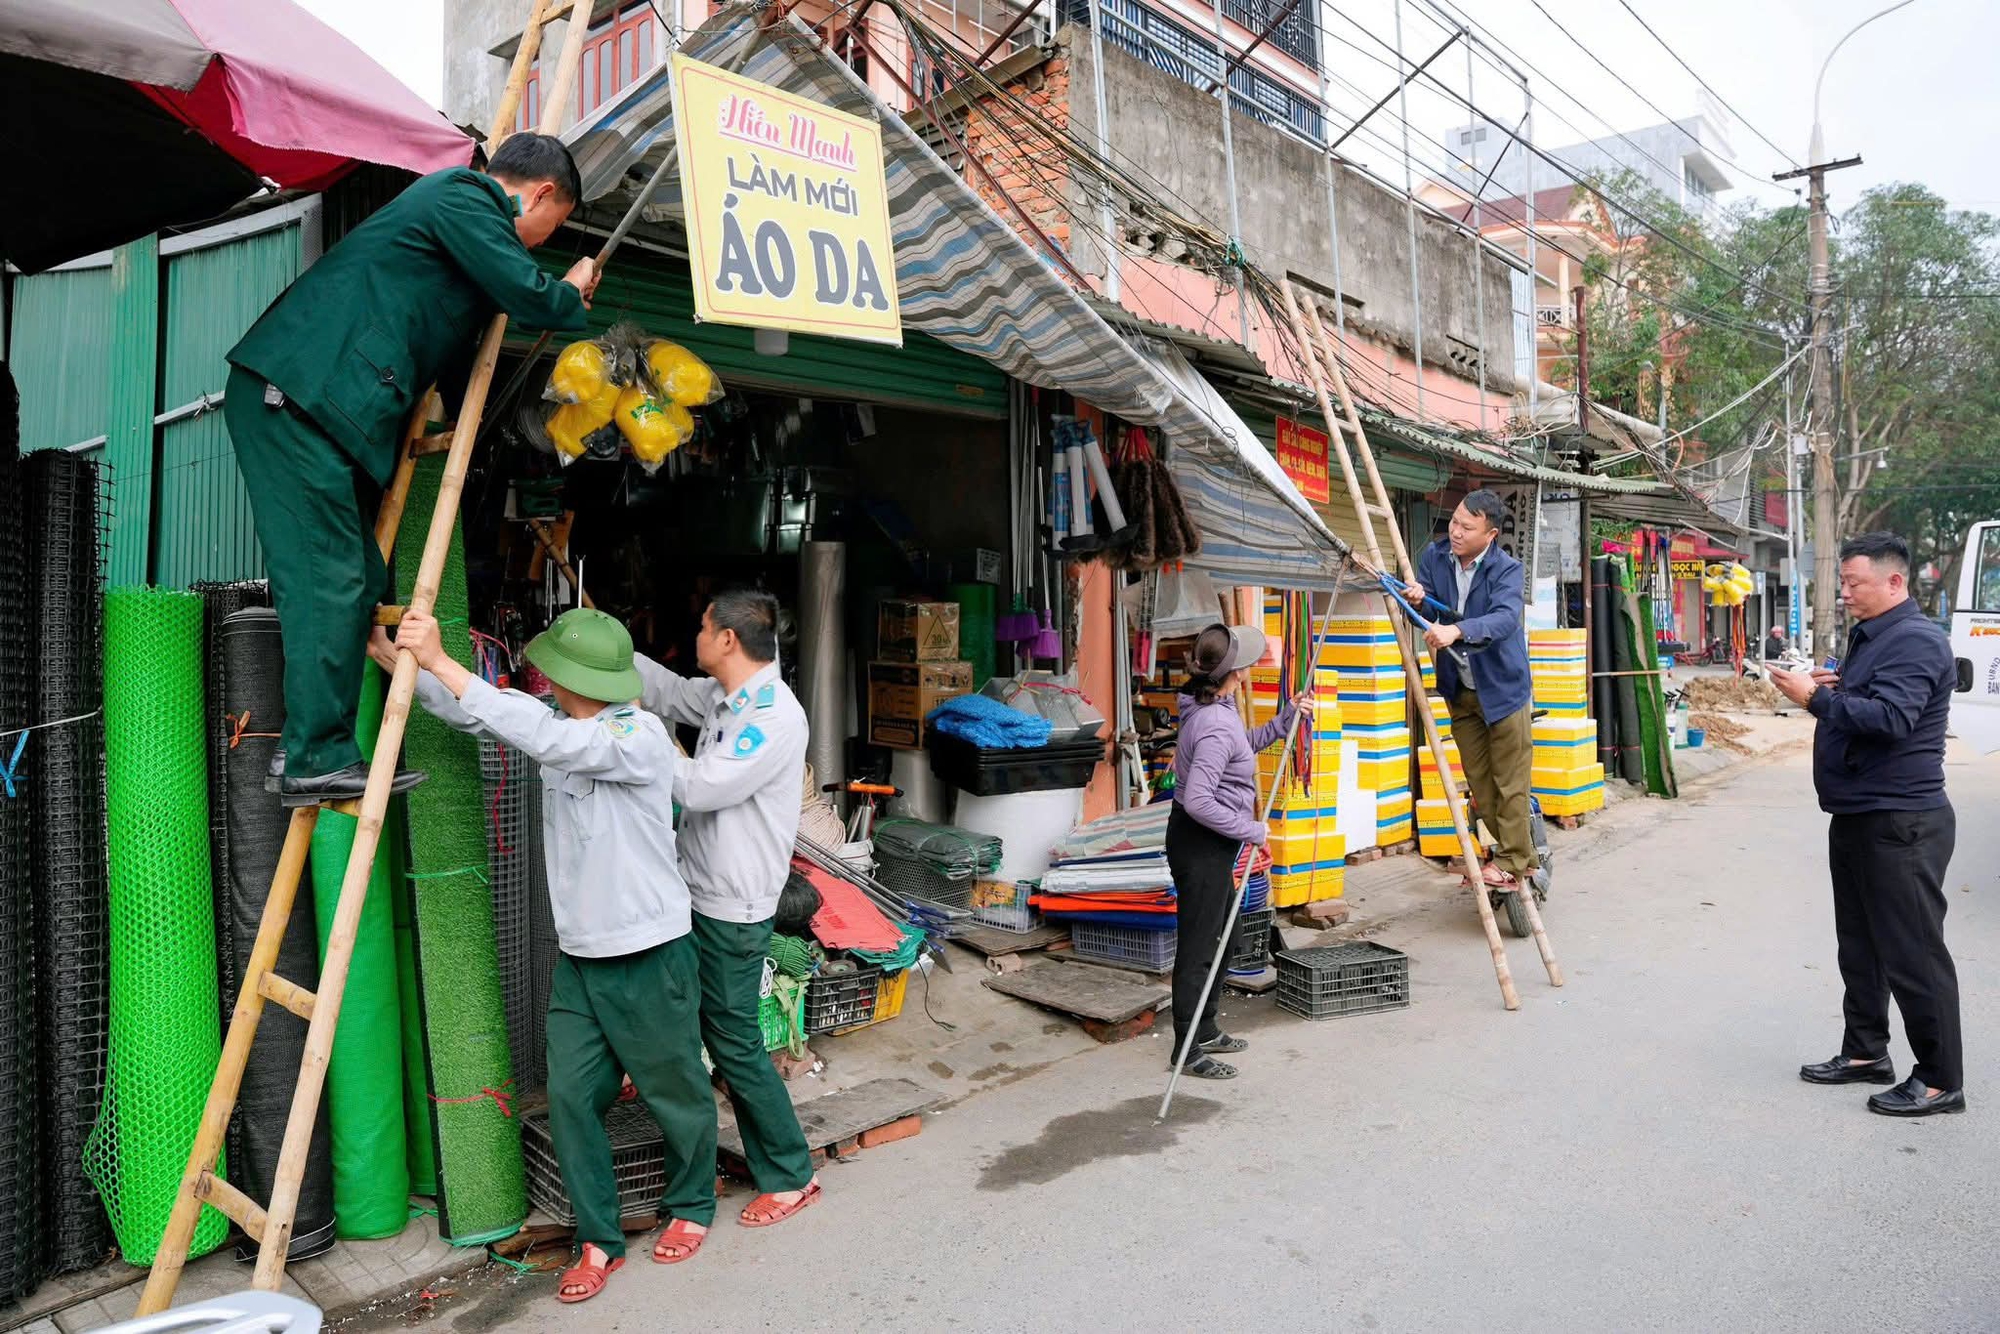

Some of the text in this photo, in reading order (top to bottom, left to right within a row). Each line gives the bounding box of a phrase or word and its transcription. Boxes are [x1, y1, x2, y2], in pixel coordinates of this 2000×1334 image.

[727, 153, 859, 217] LÀM MỚI
[715, 193, 889, 311] ÁO DA
[1501, 490, 1517, 536] DA
